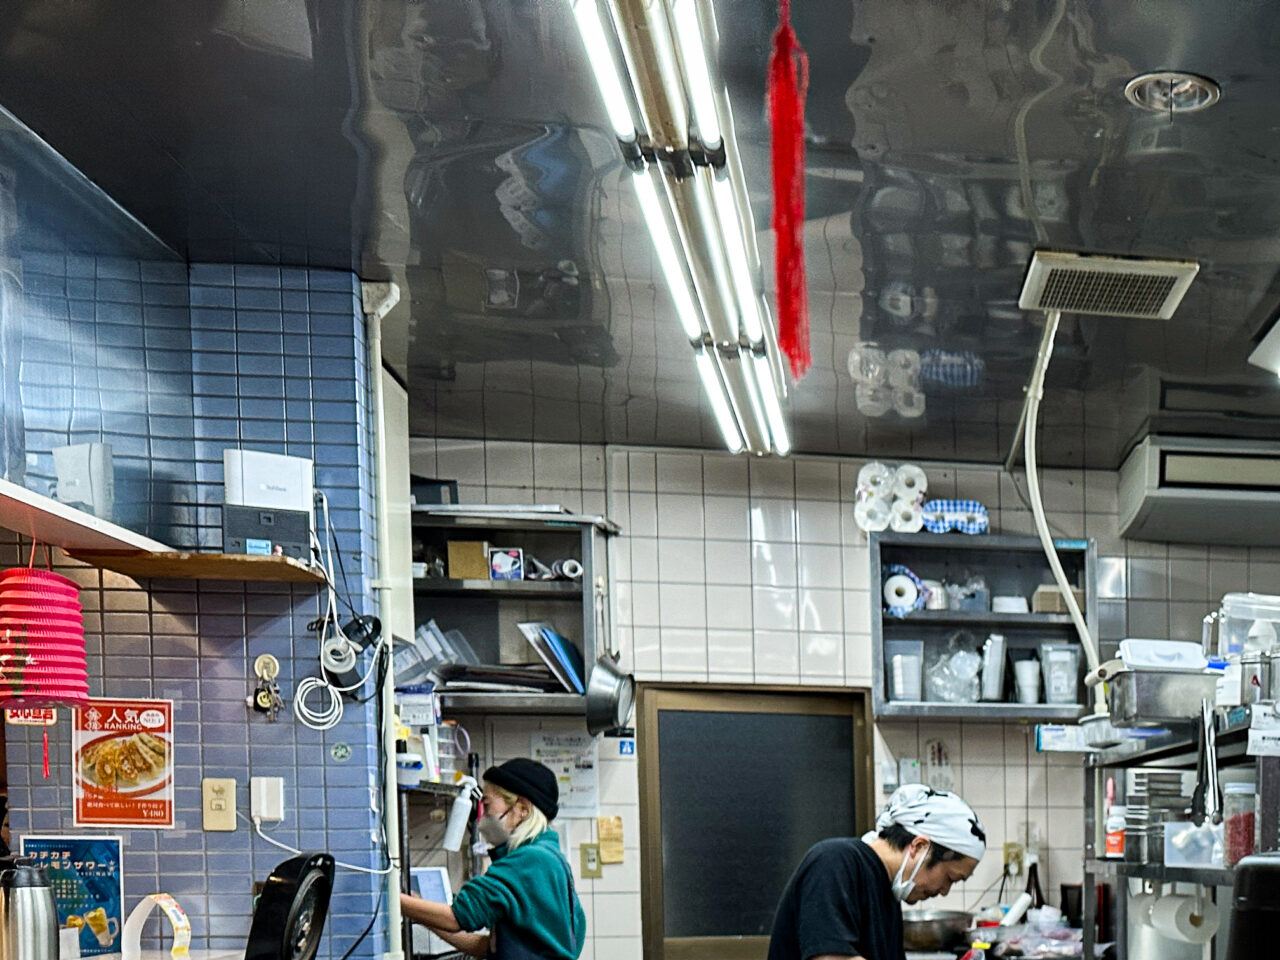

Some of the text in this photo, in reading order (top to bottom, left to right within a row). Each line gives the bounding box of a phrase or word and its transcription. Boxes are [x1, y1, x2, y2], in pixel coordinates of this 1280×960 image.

[106, 708, 140, 724] 人気
[104, 722, 143, 731] RANKING
[28, 851, 71, 859] カチカチ
